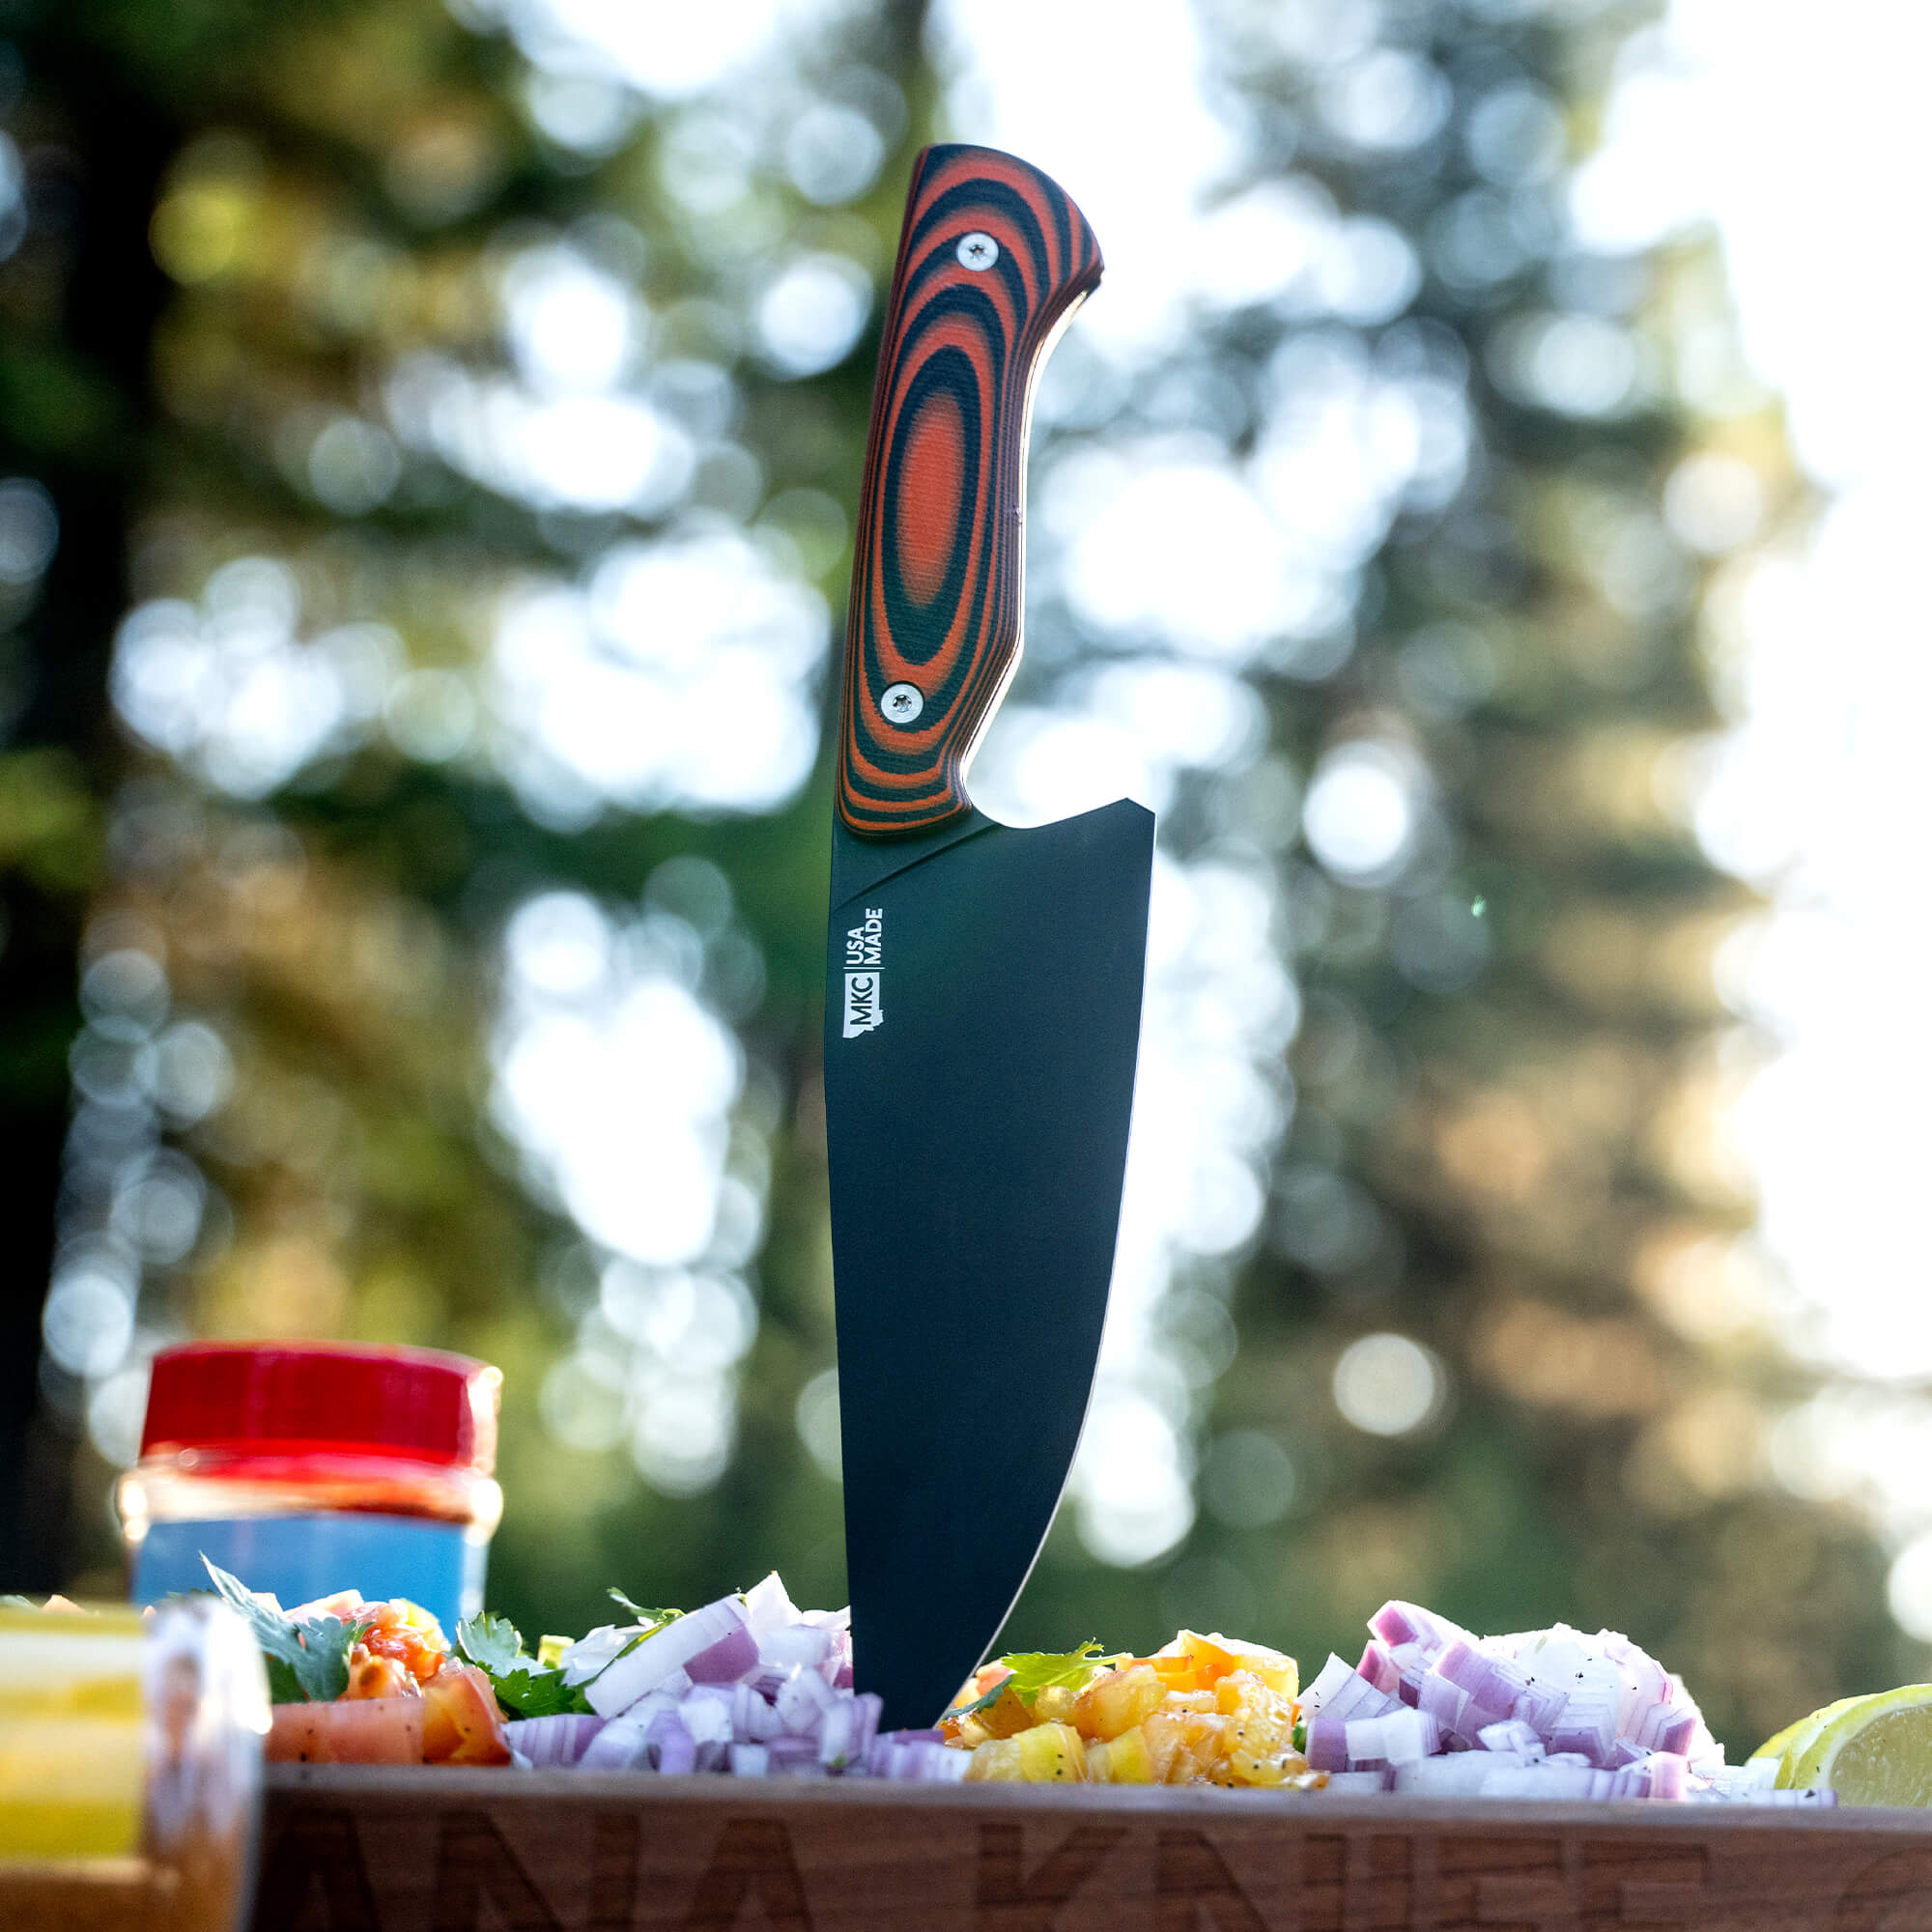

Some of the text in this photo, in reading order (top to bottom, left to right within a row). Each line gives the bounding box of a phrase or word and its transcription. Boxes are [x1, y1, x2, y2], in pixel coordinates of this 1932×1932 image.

[845, 926, 865, 964] USA
[864, 908, 883, 964] MADE
[849, 977, 874, 1026] MKC
